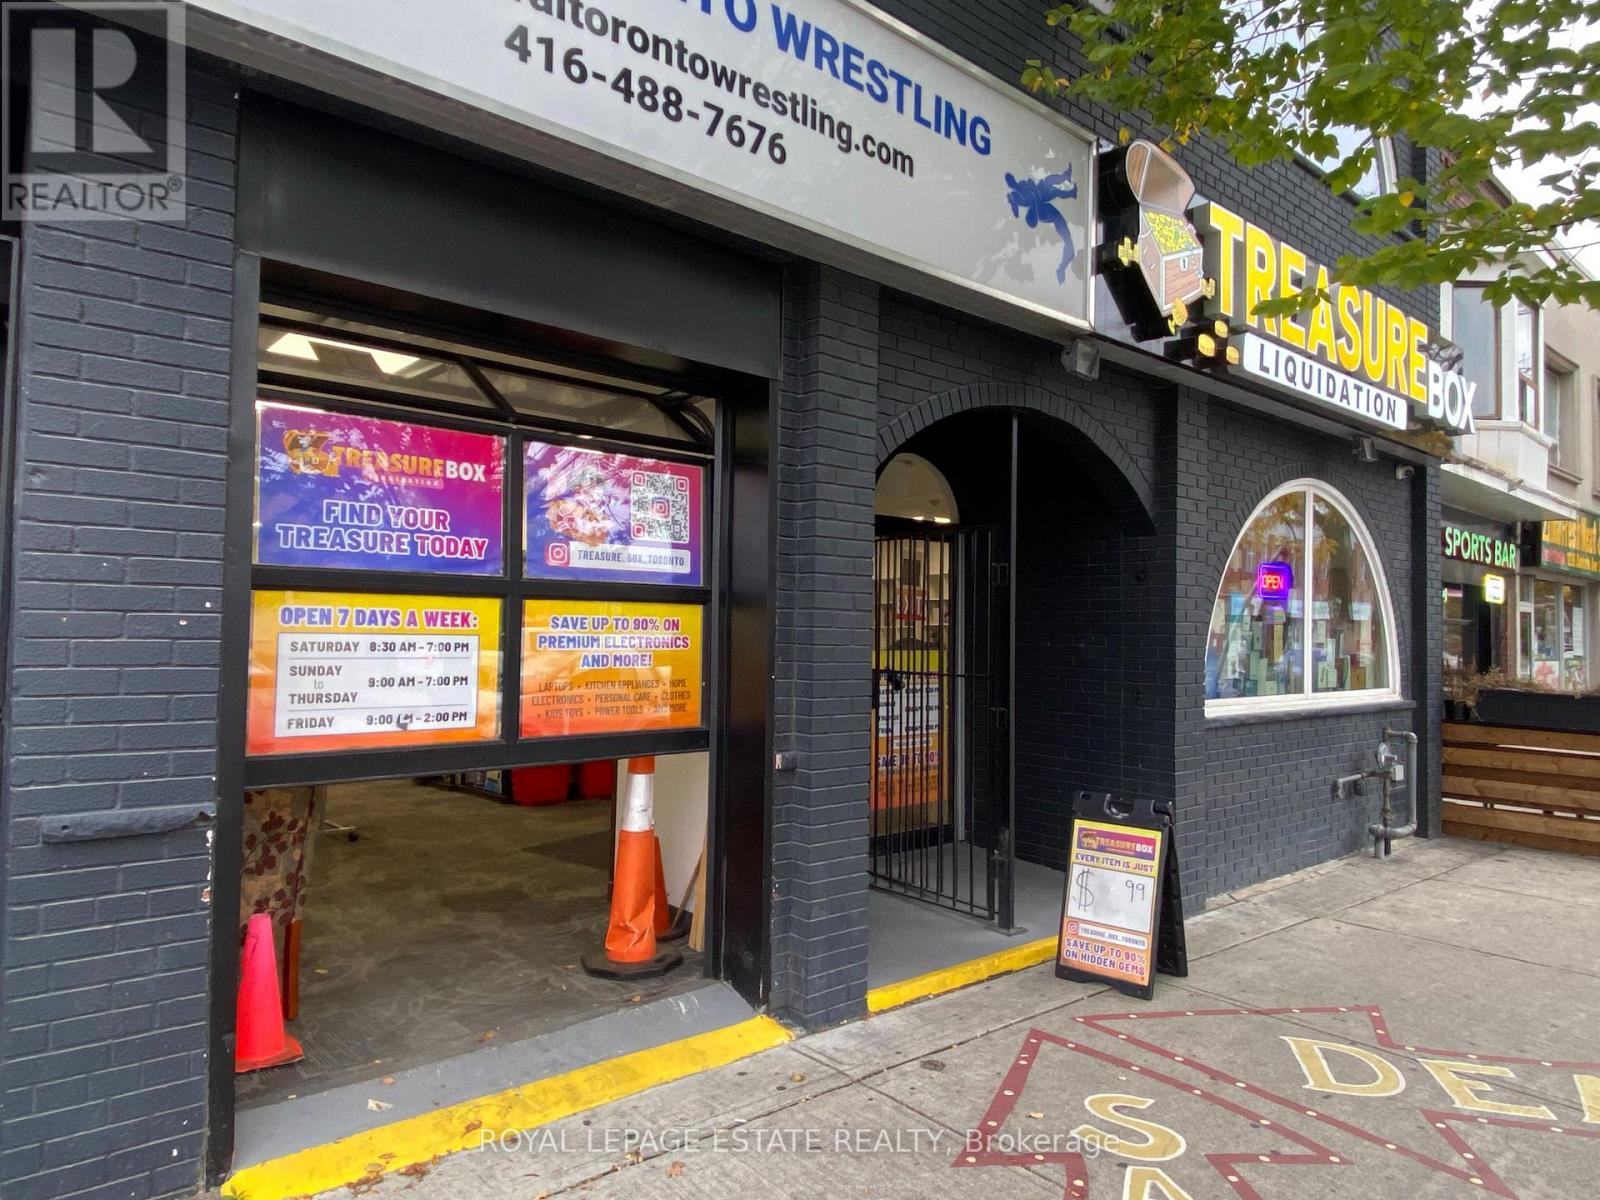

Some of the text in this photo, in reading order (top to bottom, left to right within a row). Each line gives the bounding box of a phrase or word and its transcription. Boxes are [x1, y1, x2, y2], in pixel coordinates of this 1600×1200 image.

[771, 4, 991, 155] WRESTLING
[504, 25, 786, 164] 416-488-7676
[529, 0, 914, 177] altorontowrestling.com
[1259, 343, 1396, 423] LIQUIDATION
[323, 500, 450, 532] FIND YOUR
[276, 523, 488, 560] TREASURE TODAY
[1445, 526, 1491, 564] SPORTS
[1494, 539, 1516, 569] BAR
[1262, 573, 1283, 590] OPEN
[280, 607, 478, 628] OPEN 7 DAYS A WEEK:
[551, 616, 680, 631] SAVE UP TO 90% ON
[290, 641, 360, 652] SATURDAY
[369, 642, 396, 652] 8:30
[399, 642, 416, 652] AM
[427, 642, 450, 652] 7:00
[454, 642, 469, 652] PM
[538, 635, 689, 649] PREMIUM ELECTRONICS
[581, 654, 652, 668] AND MORE!
[289, 665, 342, 676] SUNDAY
[314, 680, 324, 690] to
[368, 677, 395, 688] 9:00
[398, 677, 415, 687] AM
[426, 676, 450, 686] 7:00
[453, 676, 468, 686] PM
[538, 679, 687, 693] LAPTOPS KITCHEN APPLIANCES HOME
[289, 692, 358, 704] THURSDAY
[531, 690, 691, 706] ELECTRONICS PERSONAL CARE CLOTHES
[545, 708, 562, 719] KIDS
[564, 707, 584, 718] TOYS
[594, 706, 620, 716] POWER
[621, 704, 643, 715] TOOLS
[669, 703, 688, 712] MORE
[287, 717, 334, 729] FRIDAY
[366, 714, 393, 726] 9:00
[424, 713, 449, 723] 2:00
[452, 712, 467, 721] PM
[1075, 852, 1100, 863] EVERY
[1102, 857, 1122, 867] ITEM
[1122, 859, 1131, 868] IS
[1132, 862, 1154, 873] JUST
[1065, 937, 1145, 964] SAVE UP TO 90%
[1065, 949, 1145, 975] ON HIDDEN GEMS
